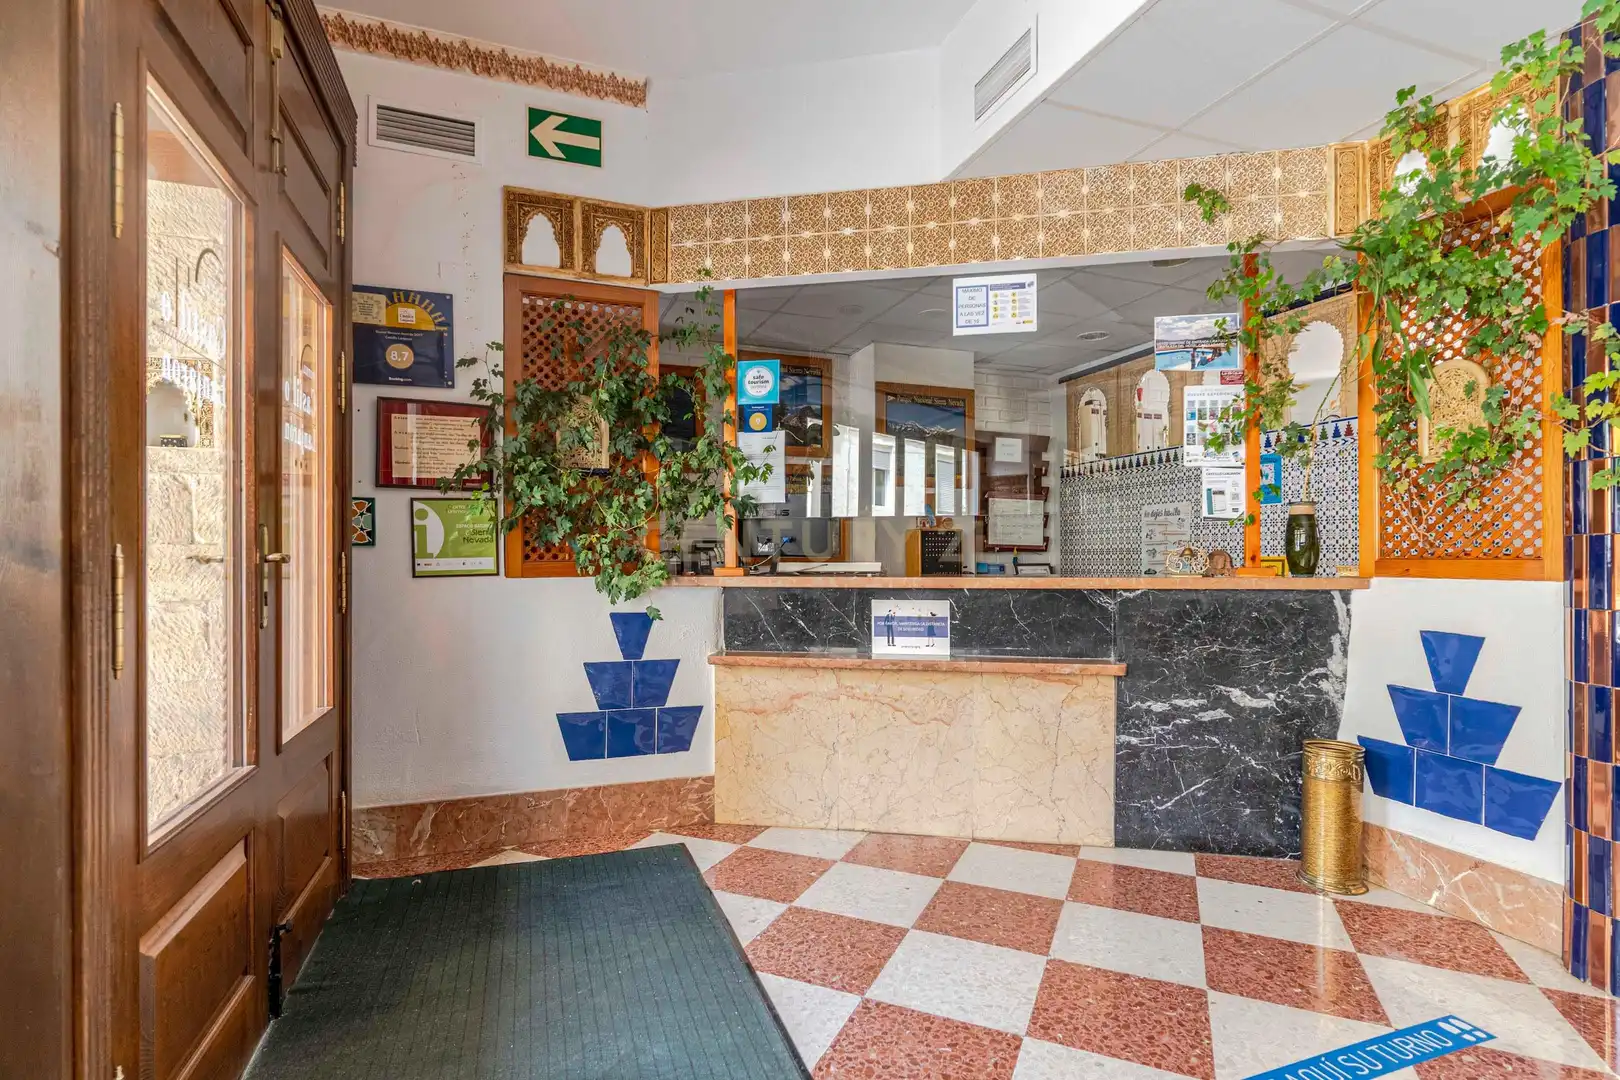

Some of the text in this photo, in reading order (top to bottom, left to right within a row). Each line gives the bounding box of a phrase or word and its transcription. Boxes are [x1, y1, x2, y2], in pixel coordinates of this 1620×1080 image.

[390, 350, 409, 362] 8.7
[1337, 1052, 1383, 1075] SU
[1366, 1029, 1453, 1063] TURNO
